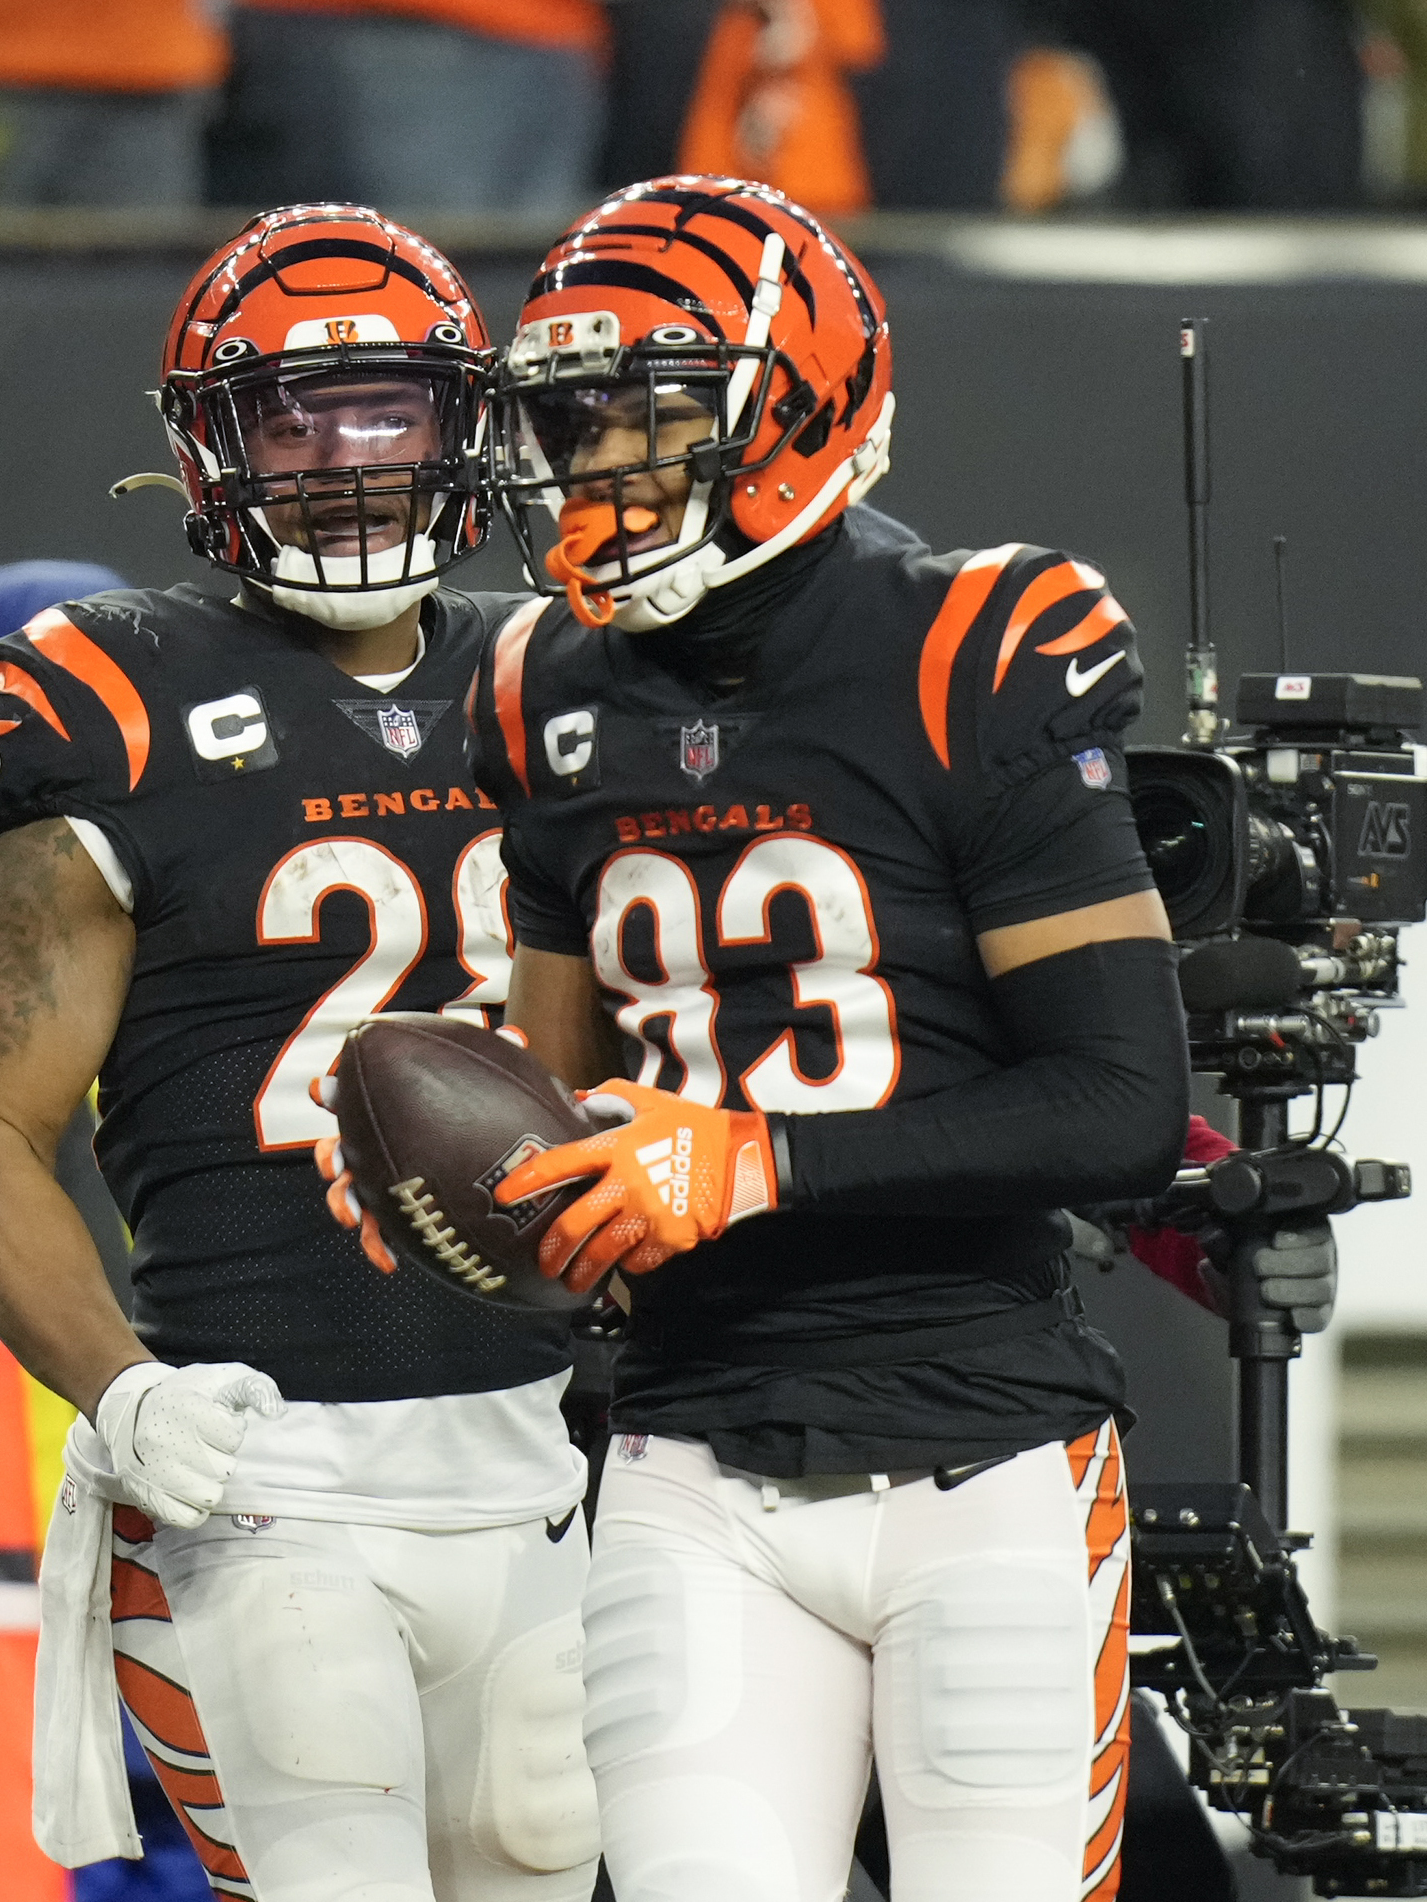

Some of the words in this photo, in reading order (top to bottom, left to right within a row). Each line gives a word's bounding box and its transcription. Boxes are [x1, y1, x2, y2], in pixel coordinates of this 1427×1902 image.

[188, 694, 267, 761] C
[388, 727, 417, 748] NFL
[544, 710, 594, 776] C
[686, 746, 713, 768] NFL
[302, 787, 498, 822] BENGAL
[614, 803, 813, 843] BENGALS
[590, 831, 902, 1115] 83
[671, 1127, 693, 1217] adidas
